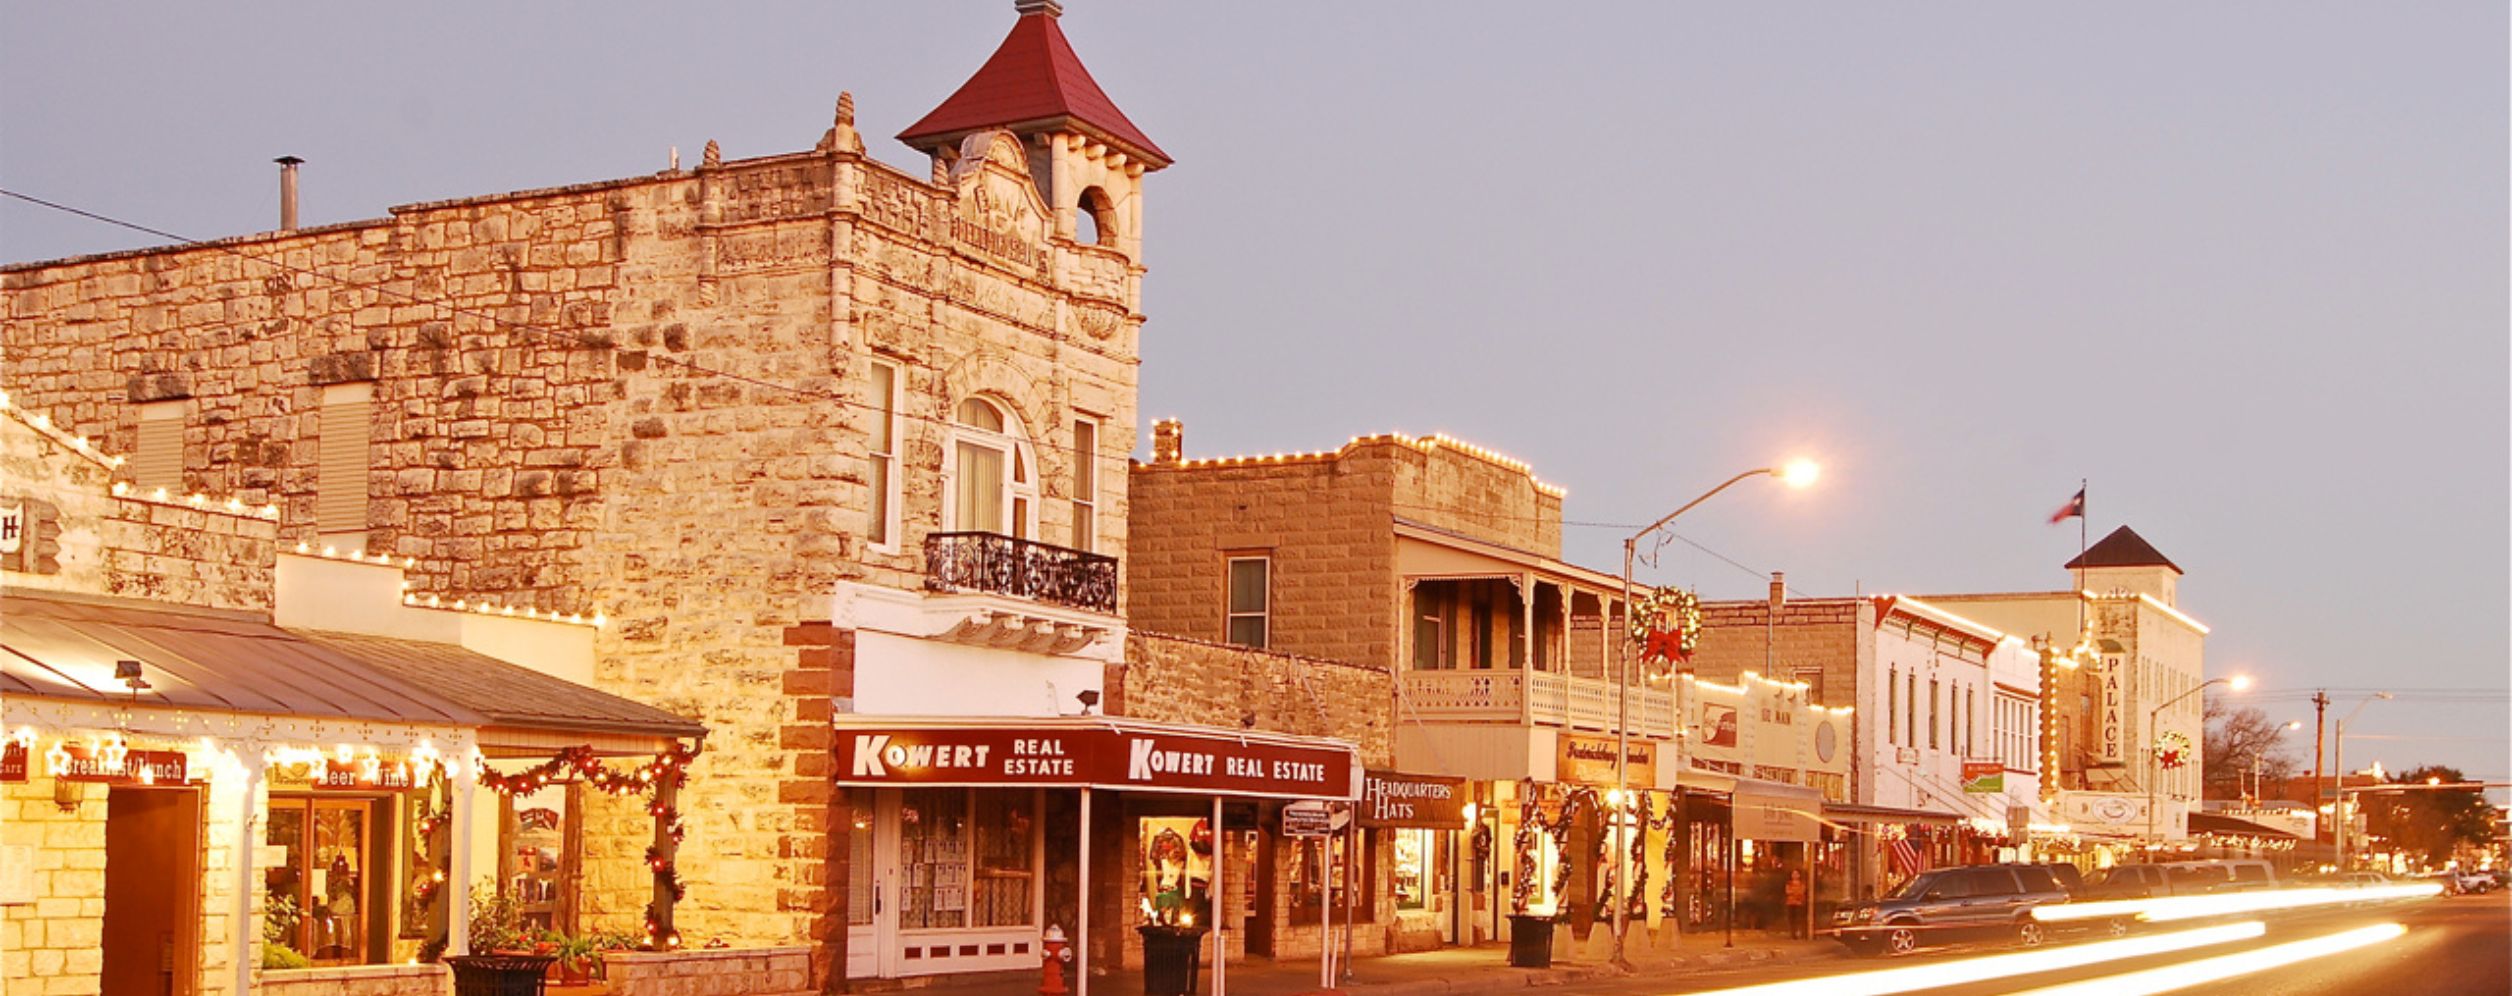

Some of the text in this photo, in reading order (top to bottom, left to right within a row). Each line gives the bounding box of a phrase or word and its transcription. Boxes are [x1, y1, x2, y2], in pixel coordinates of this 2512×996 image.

[2105, 657, 2119, 758] PALACE
[852, 735, 990, 776] KOWERT
[1013, 739, 1065, 755] REAL
[1004, 759, 1074, 775] ESTATE
[1128, 739, 1325, 782] KOWERT REAL ESTATE
[1366, 777, 1452, 800] HEADQUARTERS
[1374, 796, 1414, 819] HATS
